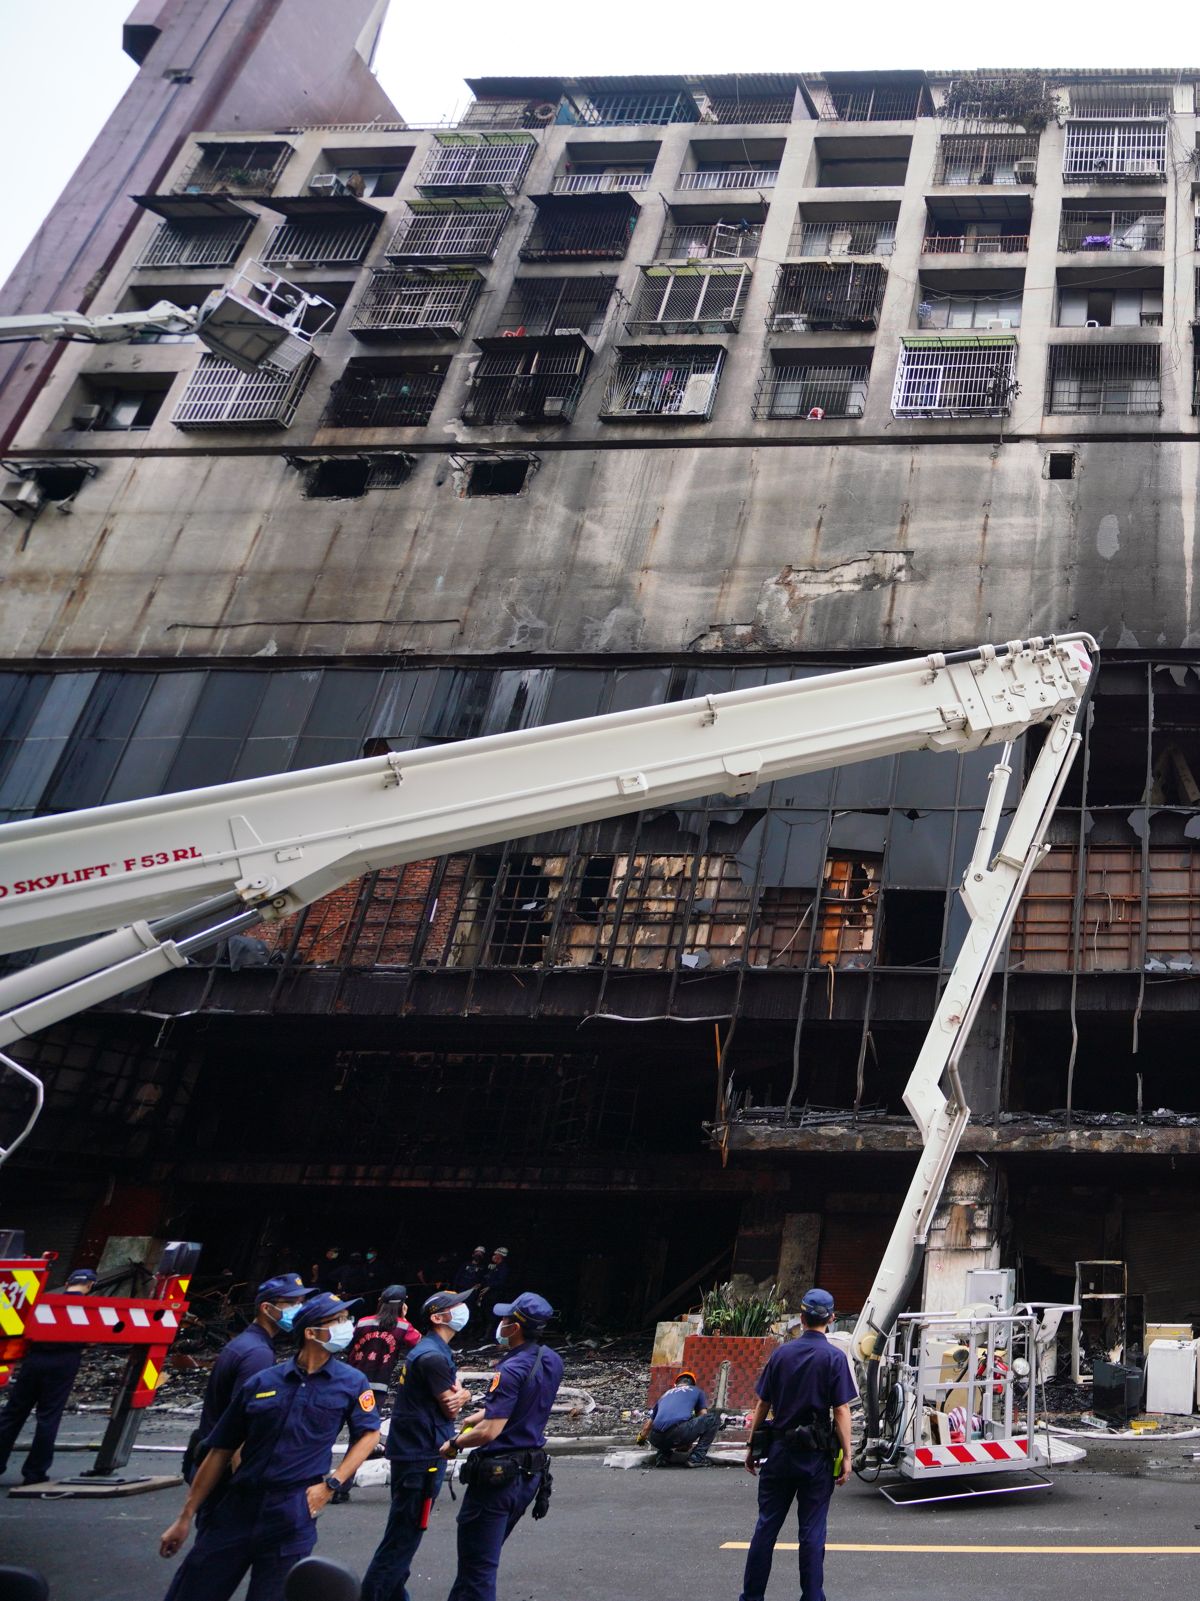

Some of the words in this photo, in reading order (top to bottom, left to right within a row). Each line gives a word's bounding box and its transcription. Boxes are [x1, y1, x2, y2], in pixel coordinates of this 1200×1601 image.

[14, 864, 110, 894] SKYLIFT
[124, 859, 136, 871] F
[141, 853, 169, 867] 53
[172, 847, 201, 861] RL
